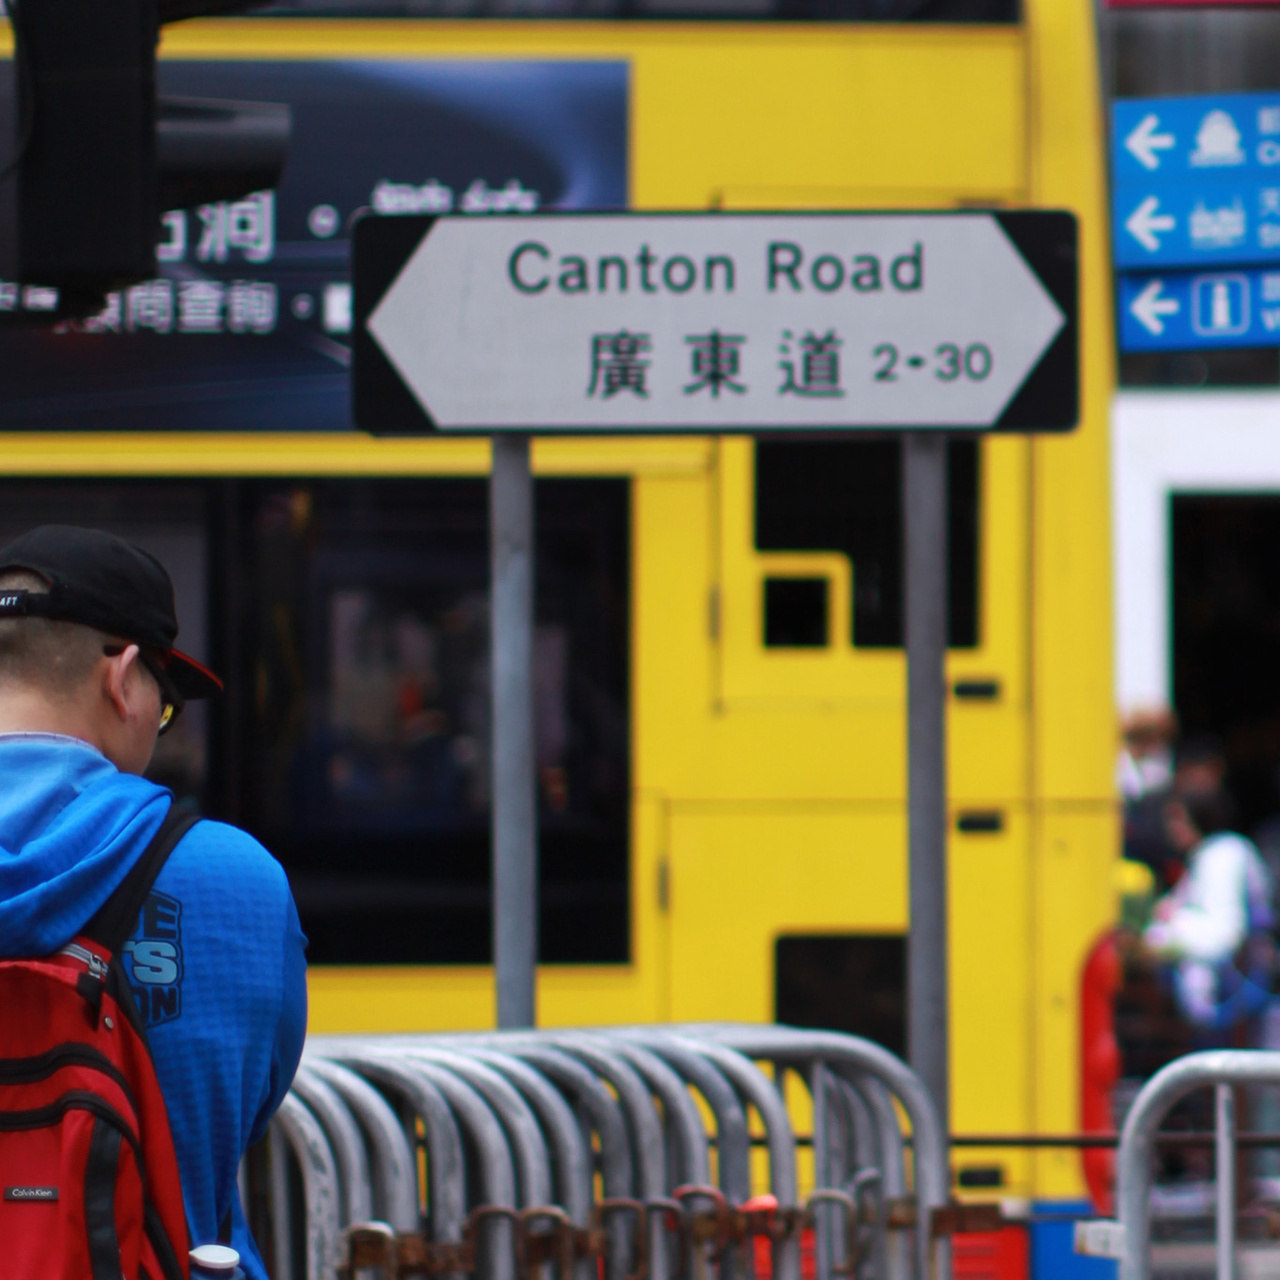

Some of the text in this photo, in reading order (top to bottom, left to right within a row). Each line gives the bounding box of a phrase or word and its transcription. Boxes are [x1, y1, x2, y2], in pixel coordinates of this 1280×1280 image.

[508, 239, 924, 294] Canton Road
[587, 328, 994, 399] 廣東道 2-30
[121, 940, 179, 985] S
[12, 1188, 53, 1197] Calvin Klein
